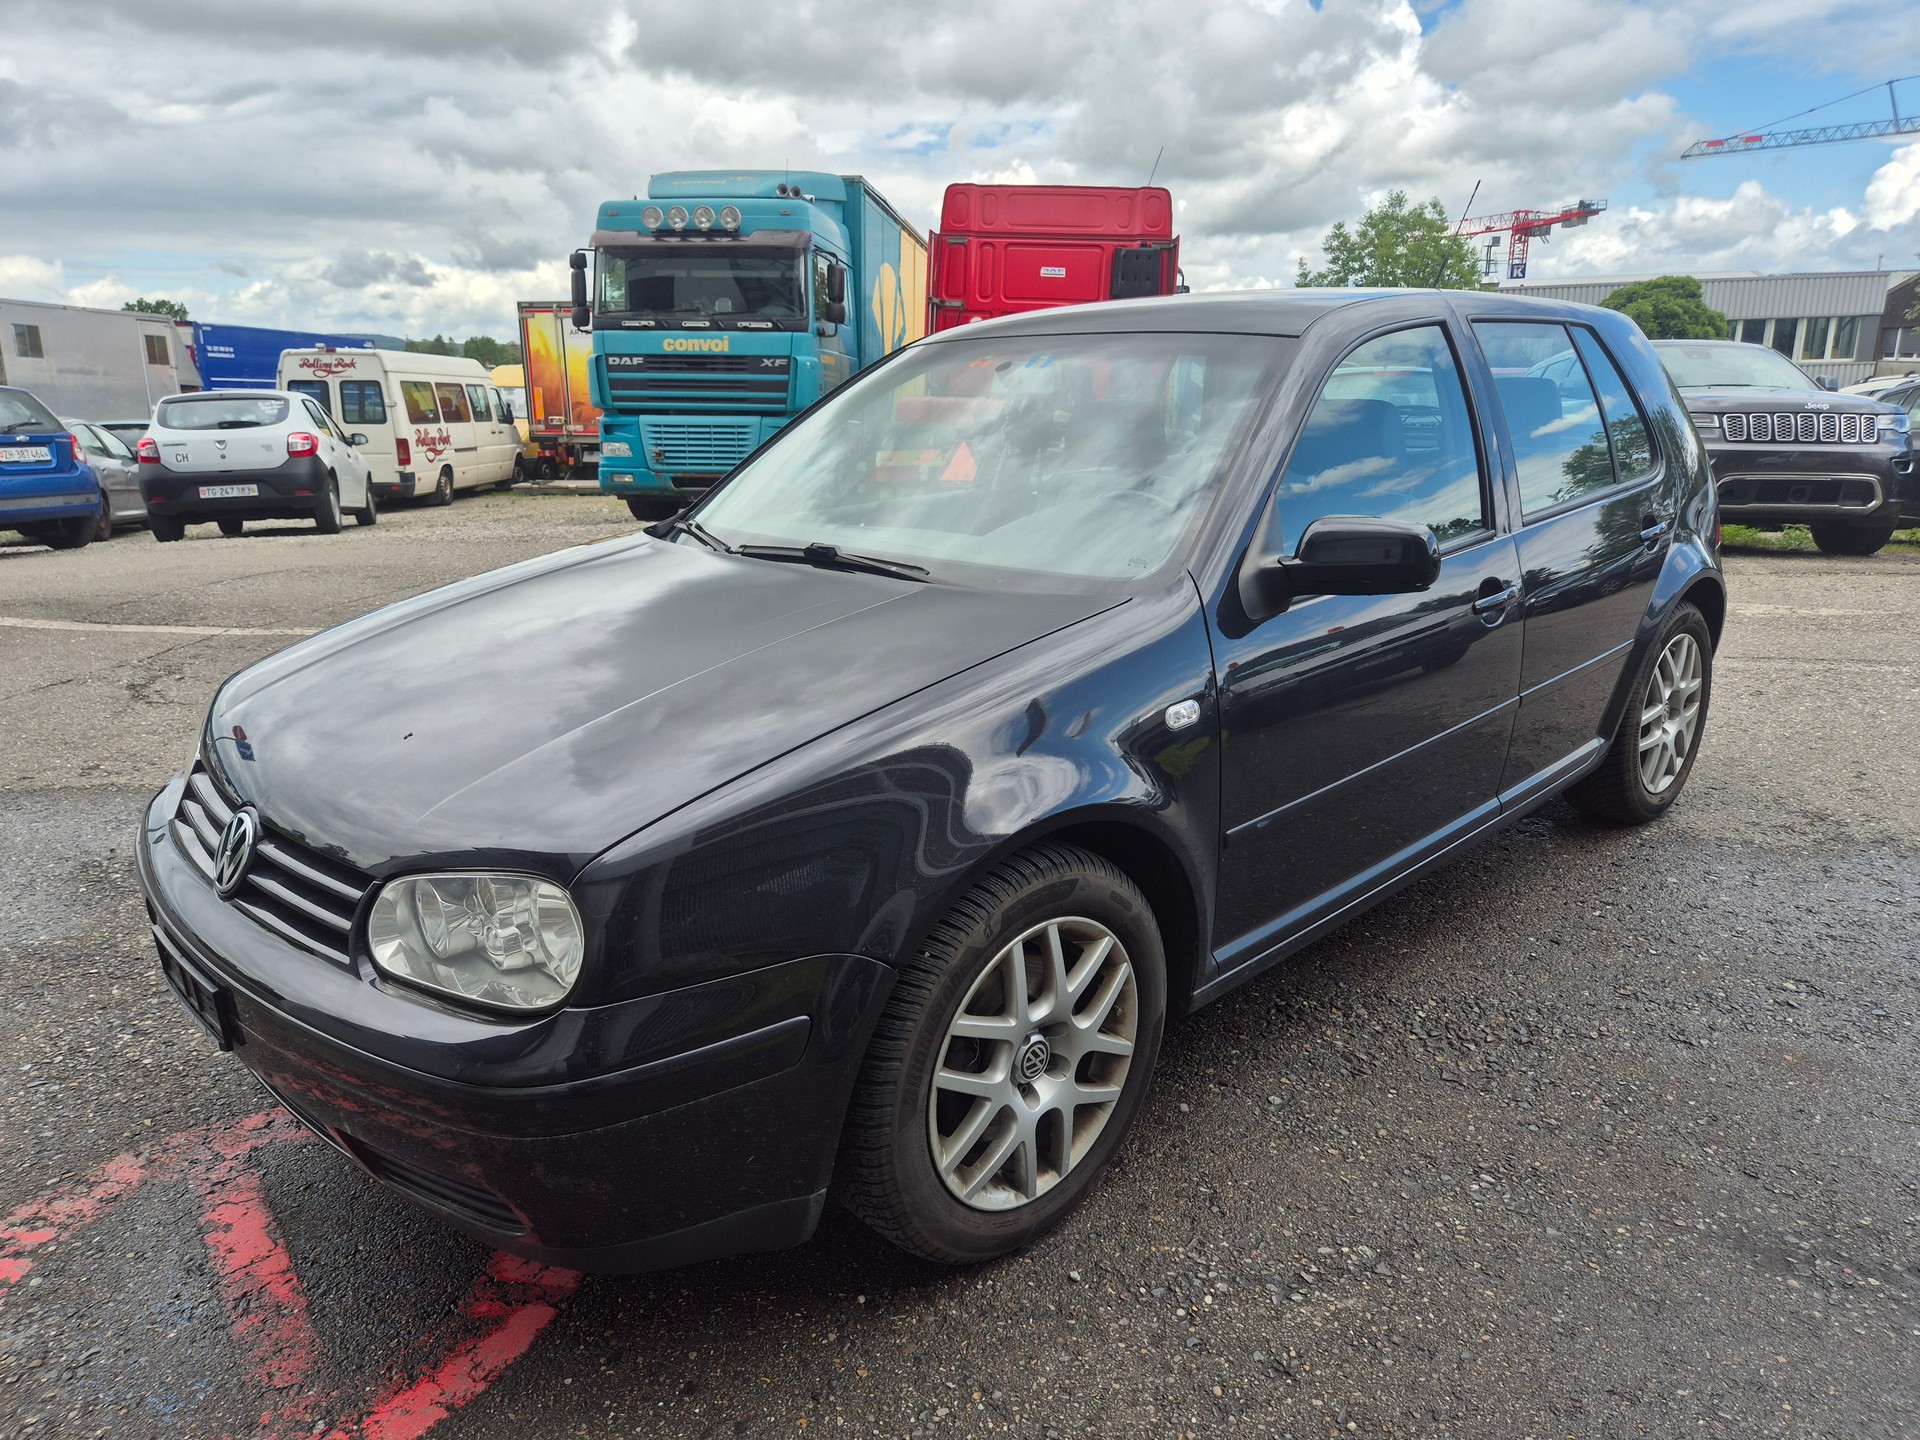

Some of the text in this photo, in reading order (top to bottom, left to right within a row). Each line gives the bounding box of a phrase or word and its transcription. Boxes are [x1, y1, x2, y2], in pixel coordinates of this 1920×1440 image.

[663, 335, 730, 352] convoi
[299, 357, 357, 373] Rolling Rock
[608, 356, 644, 365] DAF
[760, 358, 788, 367] XF
[1804, 402, 1830, 411] Jeep
[175, 453, 189, 463] CH
